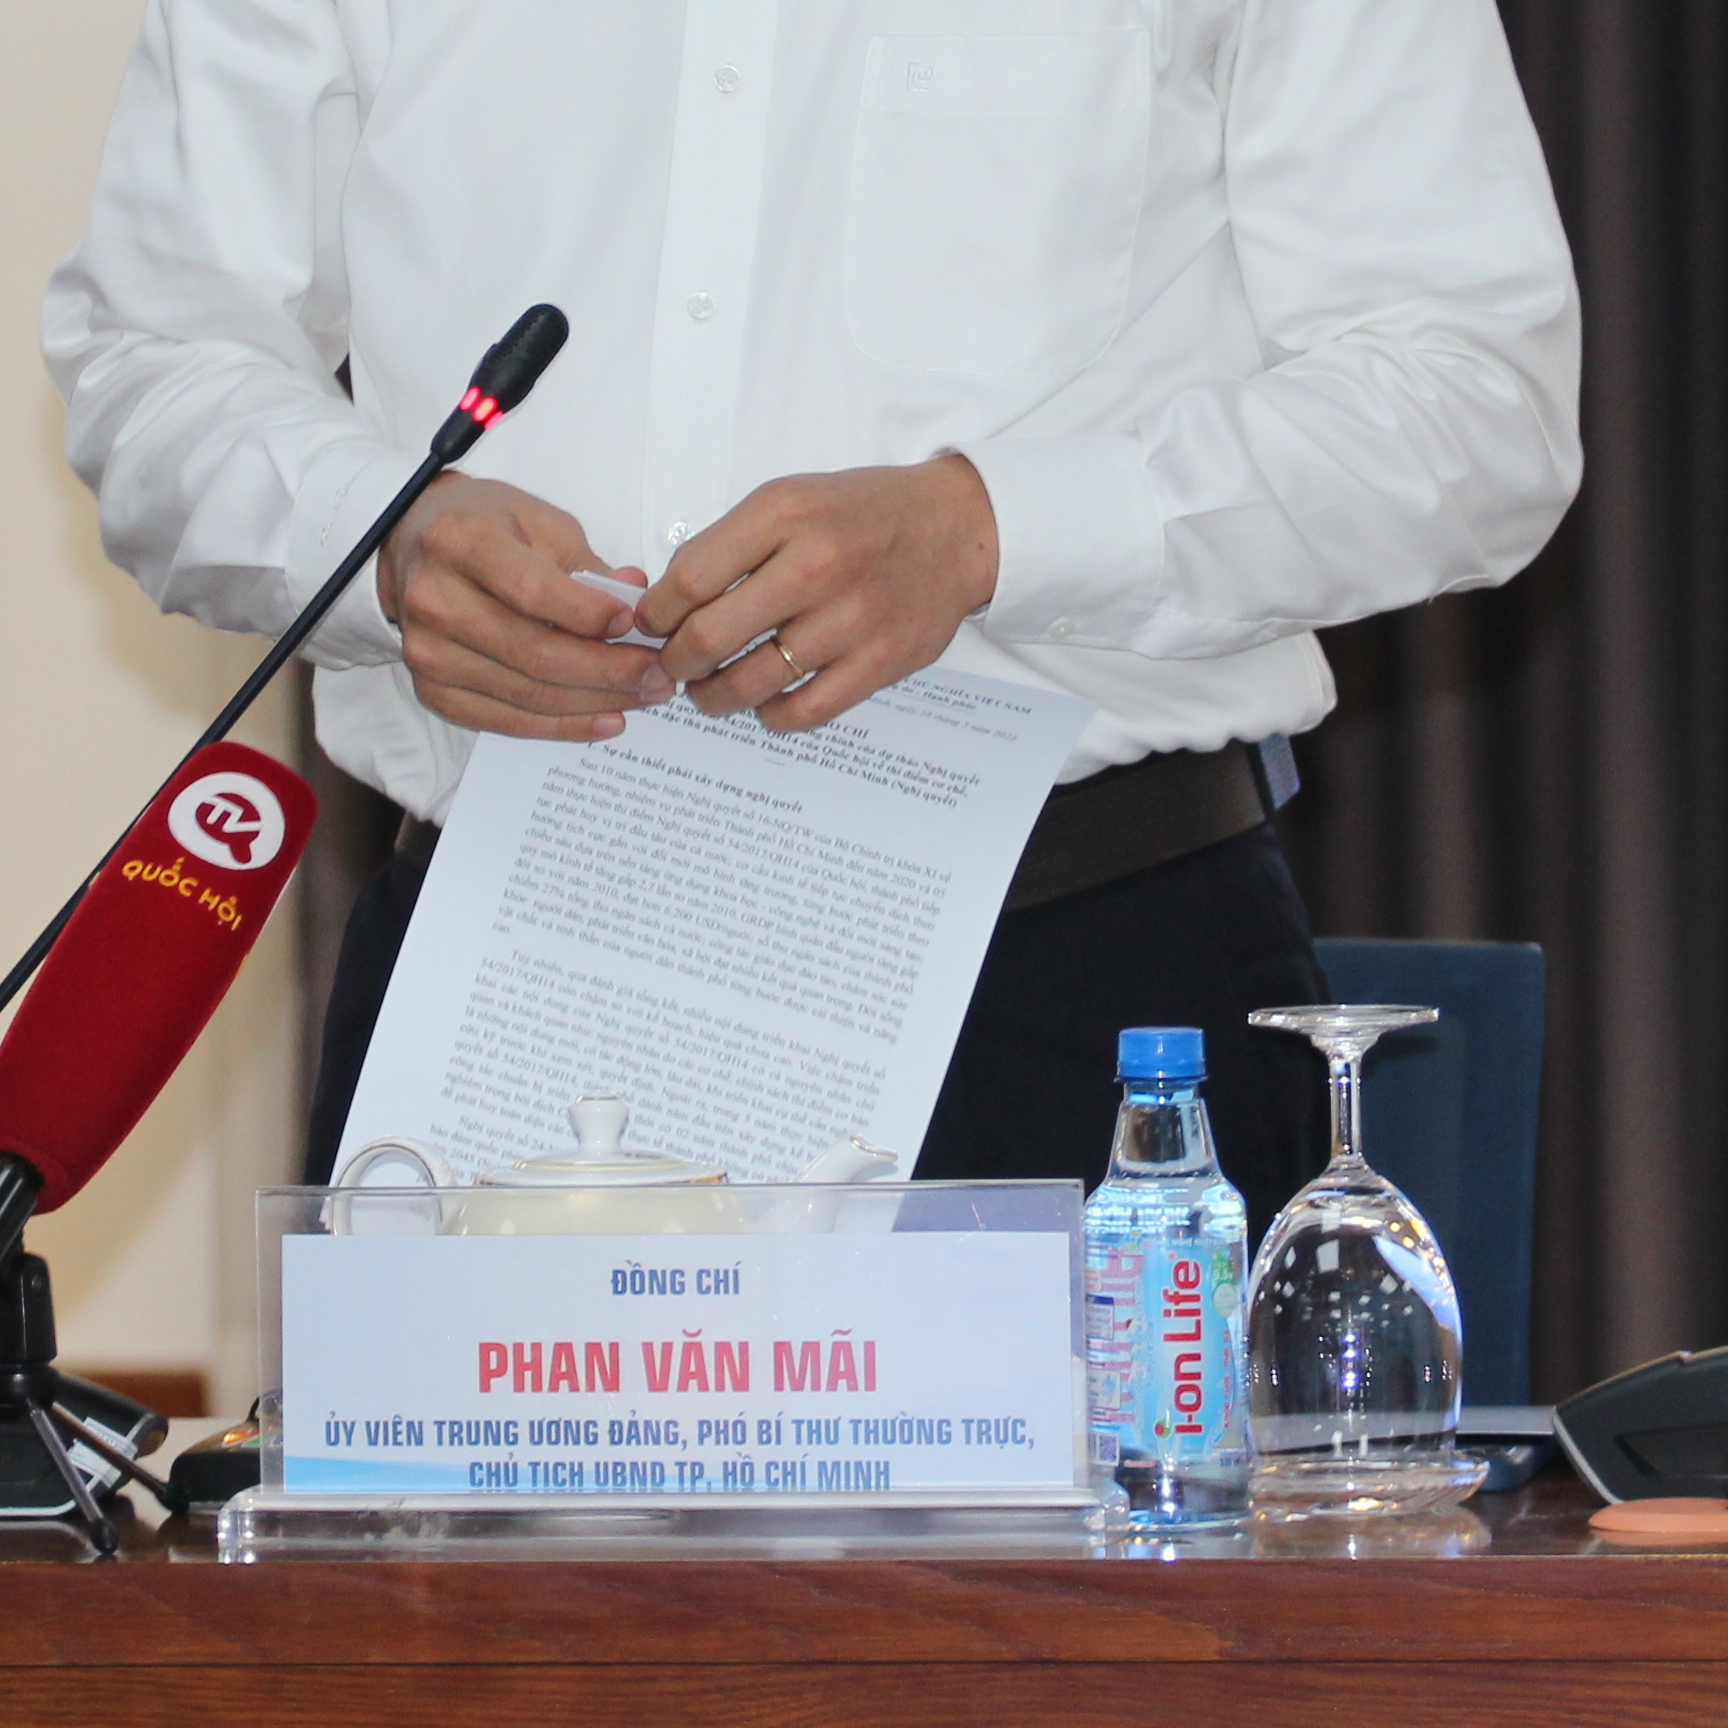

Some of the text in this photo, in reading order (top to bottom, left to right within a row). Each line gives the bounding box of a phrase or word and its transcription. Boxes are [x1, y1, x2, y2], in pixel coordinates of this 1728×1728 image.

[618, 748, 639, 763] cần
[640, 756, 667, 772] thiết
[665, 766, 693, 780] phải
[693, 773, 713, 788] xây
[714, 779, 744, 798] dựng
[744, 790, 771, 806] nghị
[770, 798, 803, 814] quyết
[122, 856, 243, 932] QUỐC HỘI
[610, 1259, 742, 1296] ĐỒNG CHÍ
[1162, 1259, 1202, 1343] Life
[478, 1328, 877, 1393] PHAN VĂN MÃI
[325, 1410, 1035, 1451] ỦY VIÊN TRUNG ƯƠNG ĐẢNG, PHÓ BÍ THƯ THƯỜNG TRỰC,
[468, 1452, 519, 1488] CHỦ
[594, 1461, 666, 1488] UBND
[674, 1461, 712, 1492] TP.
[721, 1452, 755, 1489] HỒ
[769, 1453, 808, 1490] CHÍ
[816, 1460, 891, 1491] MINH
